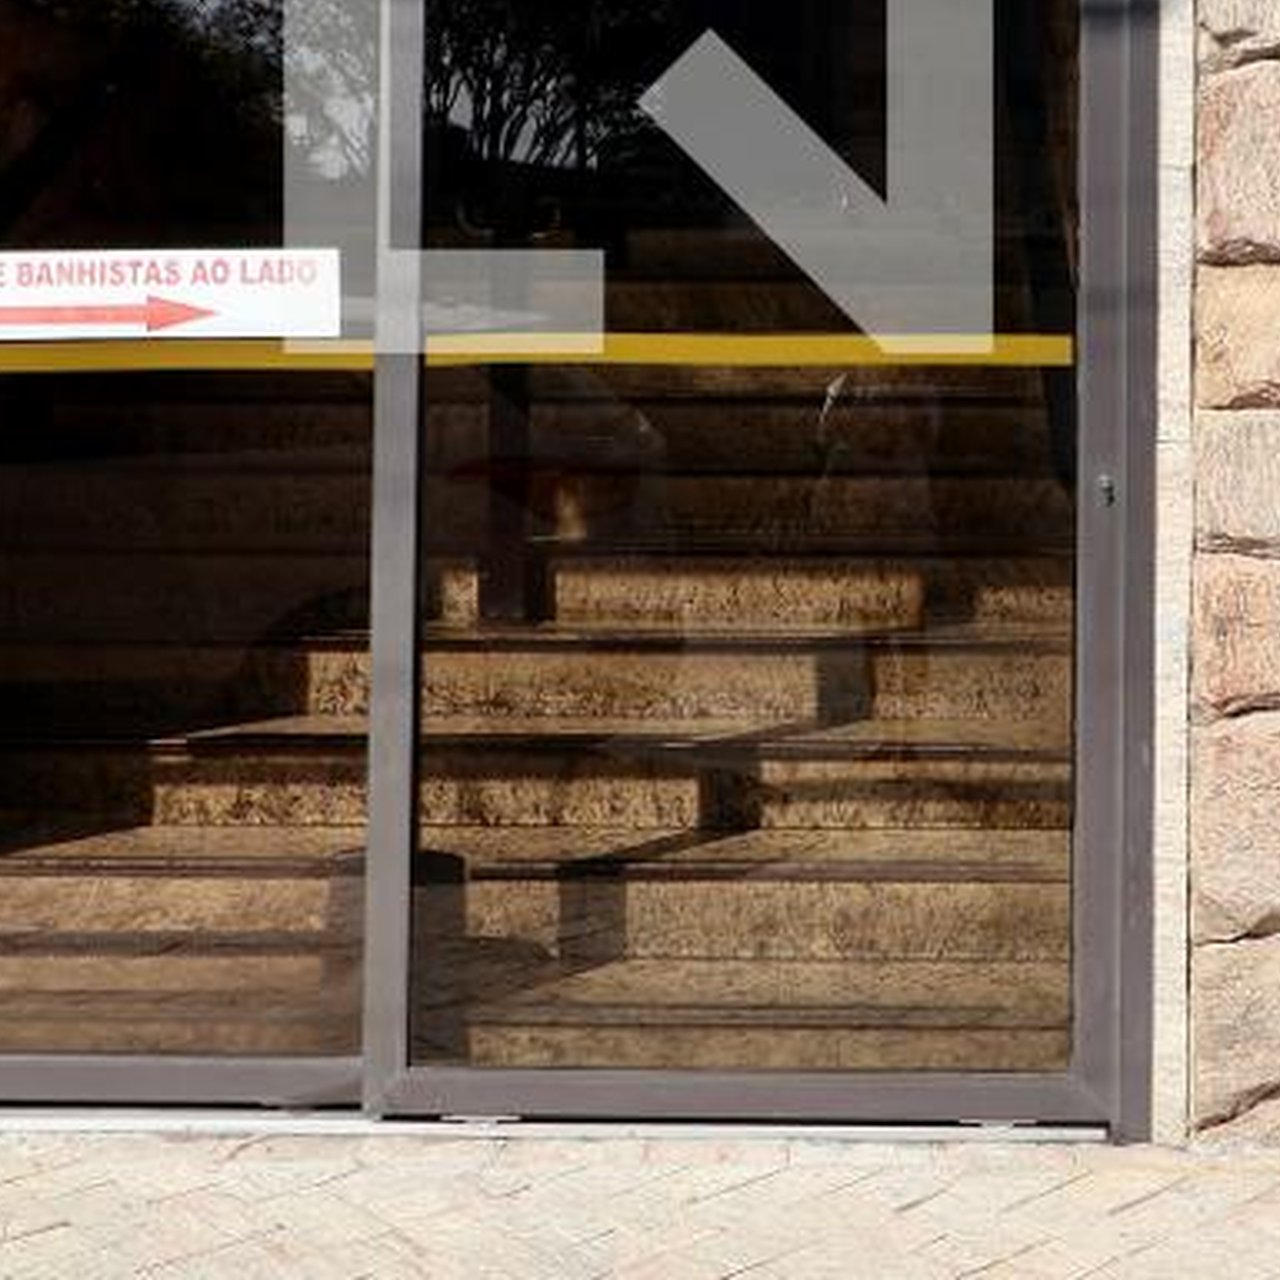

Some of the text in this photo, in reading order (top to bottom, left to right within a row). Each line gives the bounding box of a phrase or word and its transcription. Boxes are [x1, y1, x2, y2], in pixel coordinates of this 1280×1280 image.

[16, 261, 180, 287] BANHISTAS
[191, 260, 229, 284] AO
[240, 259, 317, 284] LADO
